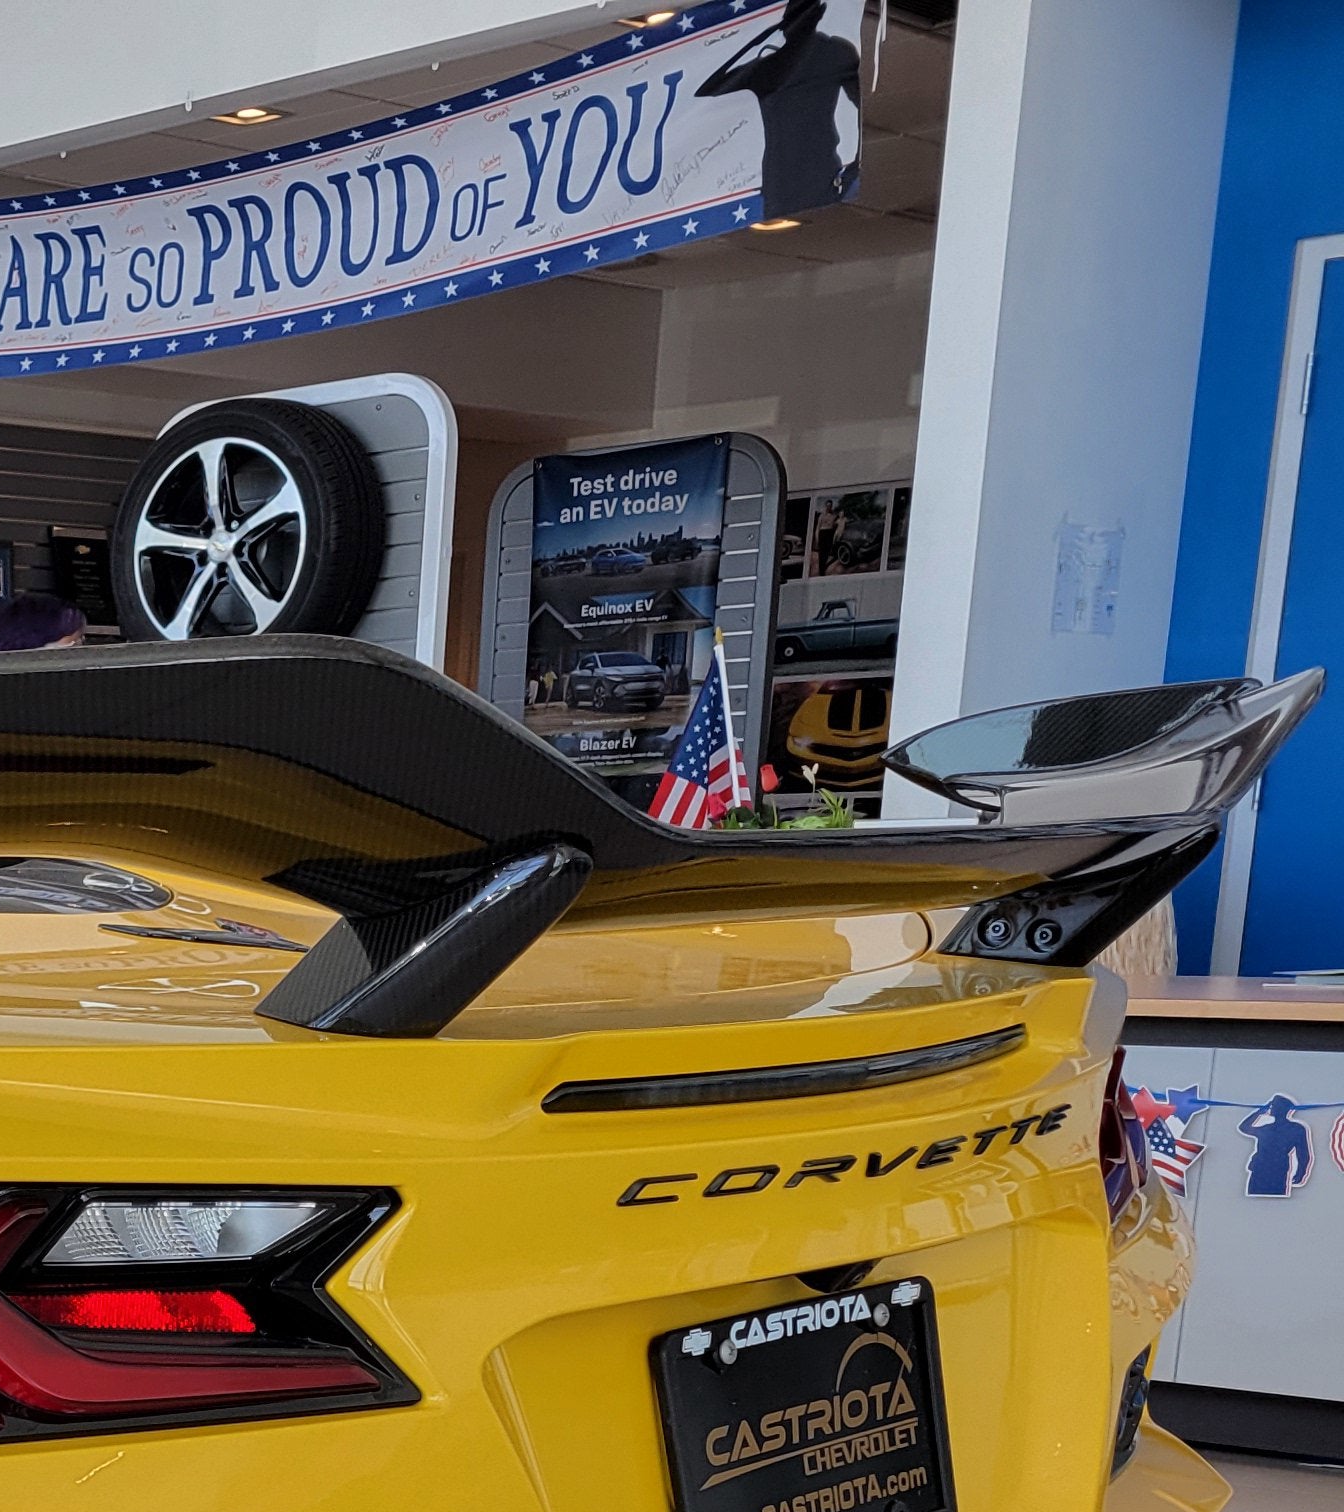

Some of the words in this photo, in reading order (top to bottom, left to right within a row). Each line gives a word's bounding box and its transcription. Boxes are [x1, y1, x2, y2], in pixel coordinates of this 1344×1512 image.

[125, 241, 186, 313] SO
[186, 154, 440, 306] PROUD
[450, 173, 507, 242] OF
[509, 70, 683, 229] YOU
[560, 506, 584, 524] an
[589, 497, 618, 520] EV
[622, 491, 689, 515] today
[570, 473, 615, 497] Test
[620, 466, 678, 491] drive
[581, 601, 633, 619] Equinox
[635, 598, 654, 613] EV
[580, 738, 620, 752] Blazer
[621, 736, 637, 750] EV
[617, 1103, 1072, 1206] CORVETTE
[730, 1294, 871, 1349] CASTRIOTA
[705, 1377, 916, 1467] CASTRIOTA
[803, 1423, 918, 1476] CHEVROLET
